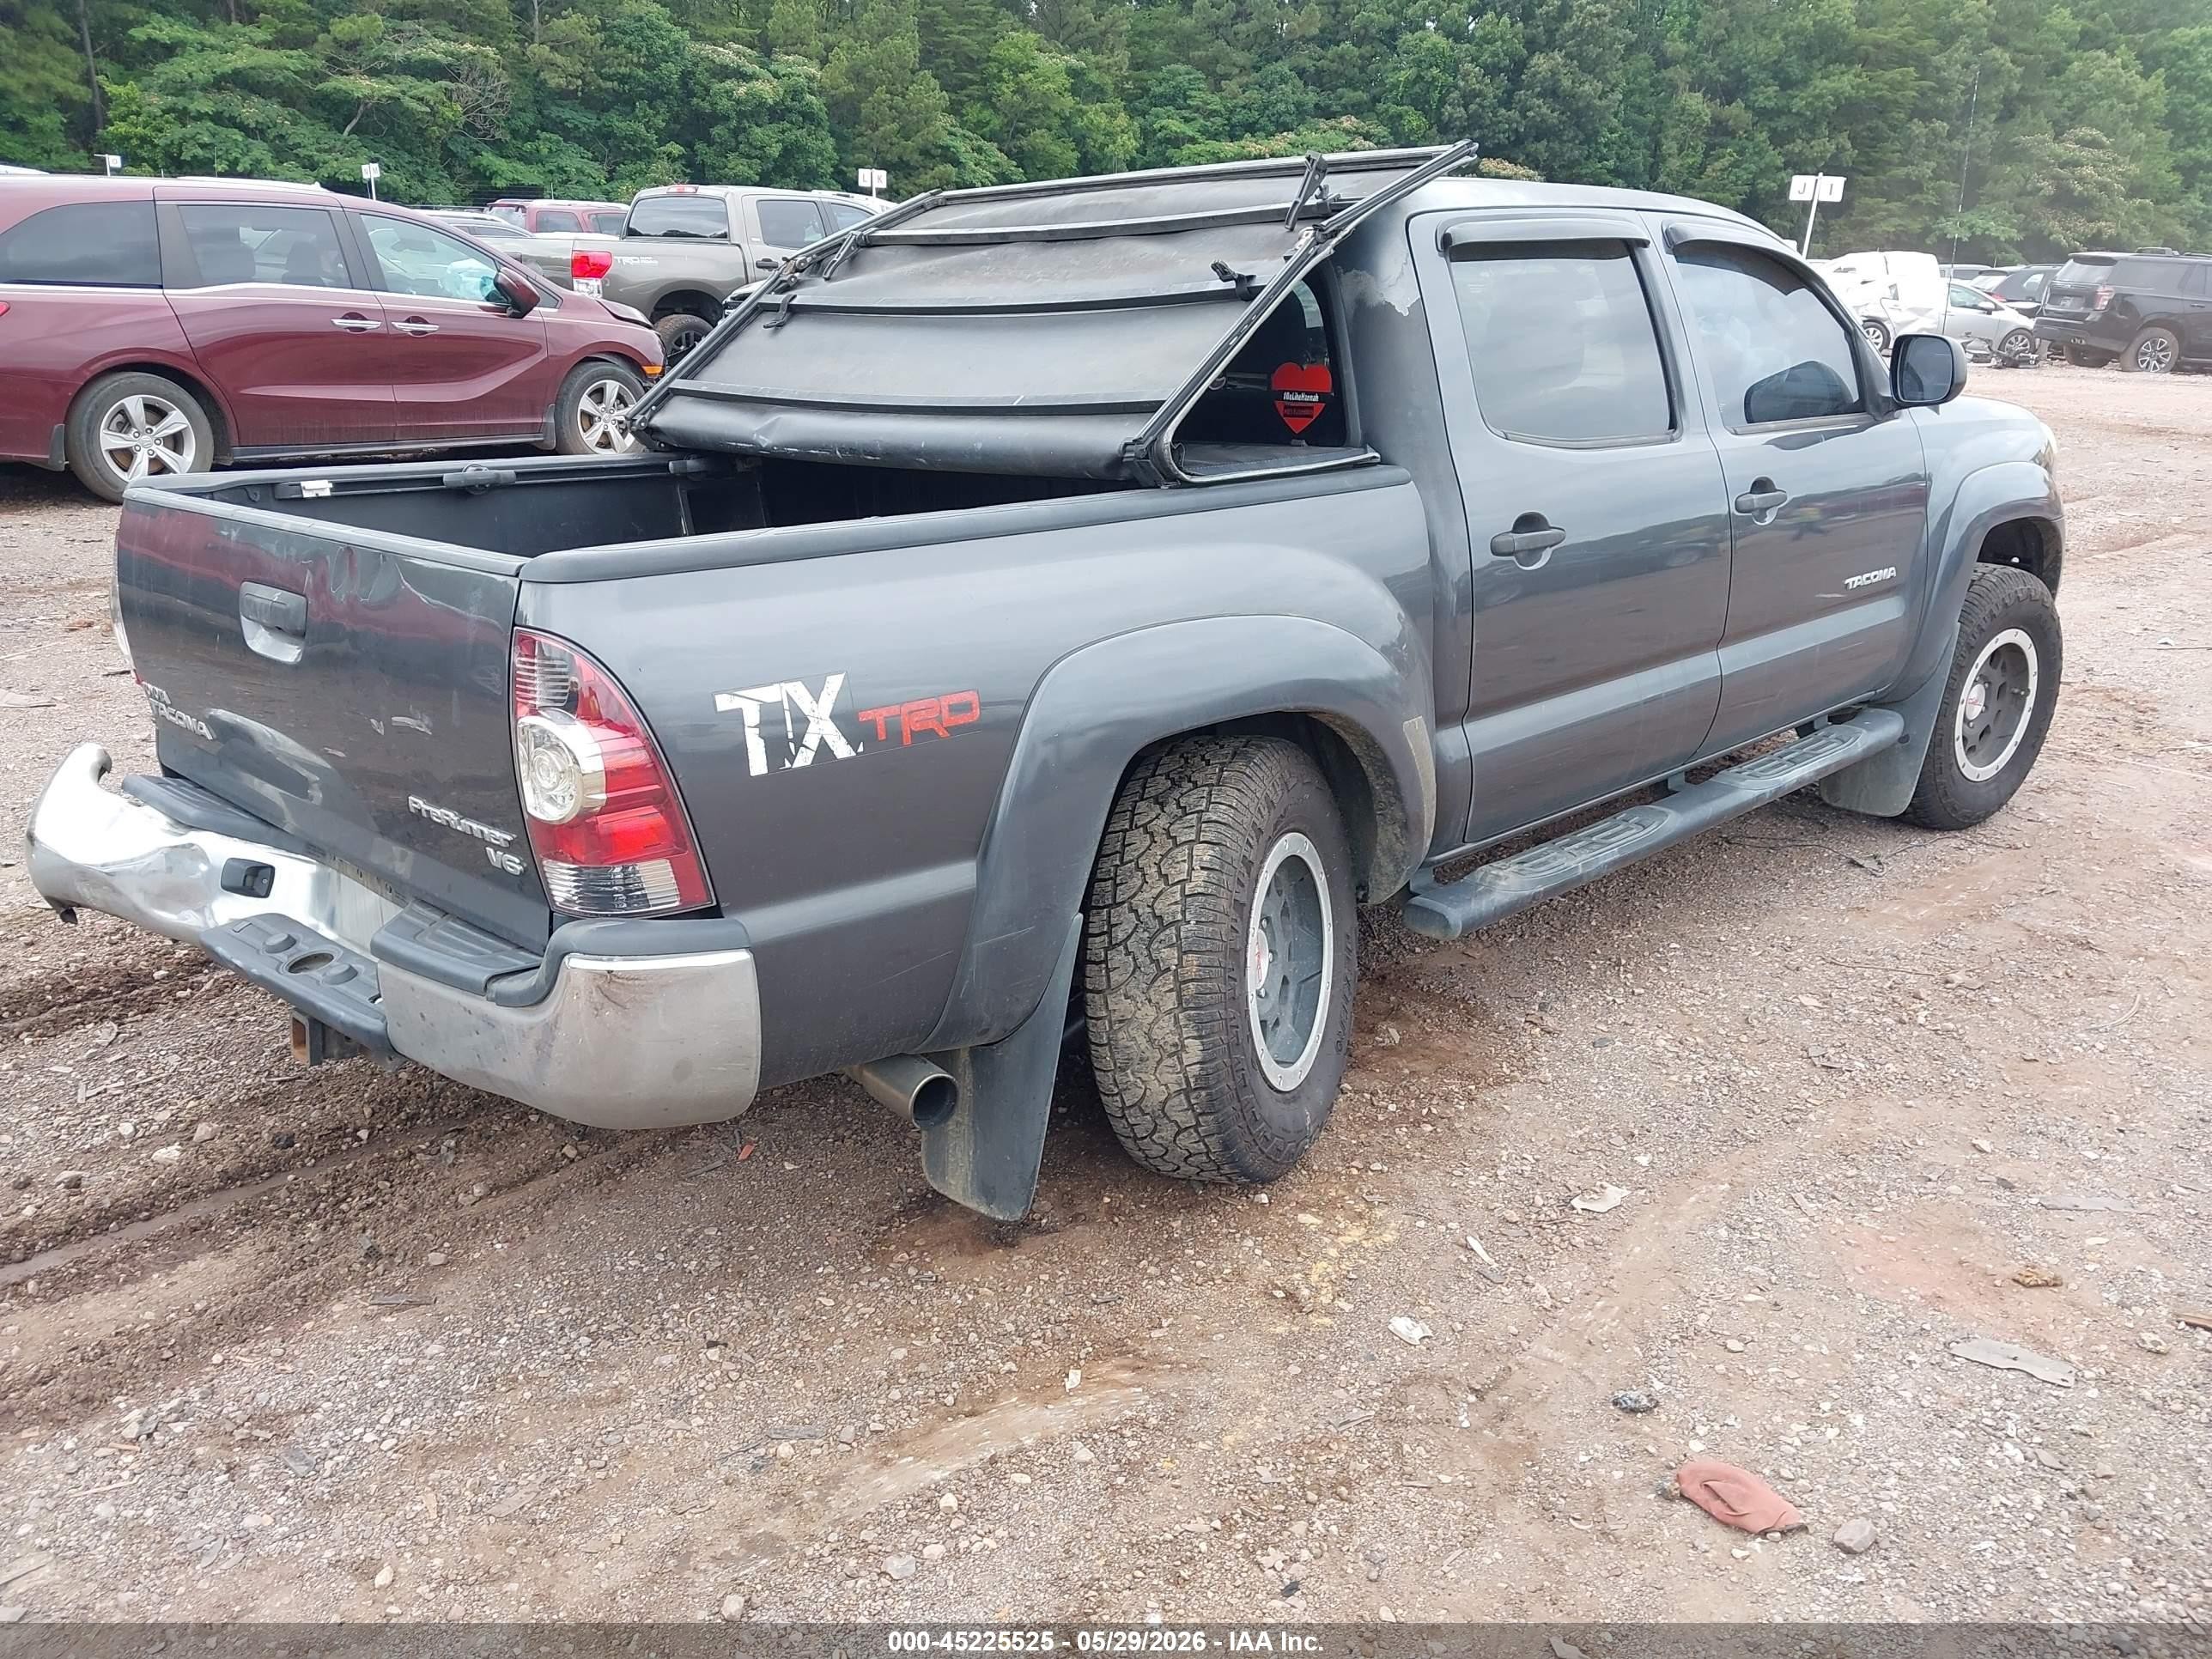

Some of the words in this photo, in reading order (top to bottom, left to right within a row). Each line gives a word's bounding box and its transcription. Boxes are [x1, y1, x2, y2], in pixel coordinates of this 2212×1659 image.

[862, 173, 868, 183] L
[877, 174, 884, 185] K
[1797, 182, 1807, 195] J
[1844, 566, 1897, 590] TACOMA
[149, 697, 215, 740] TACOMA
[858, 690, 981, 746] TRD
[408, 795, 516, 848] PreRunner
[485, 846, 525, 876] V6
